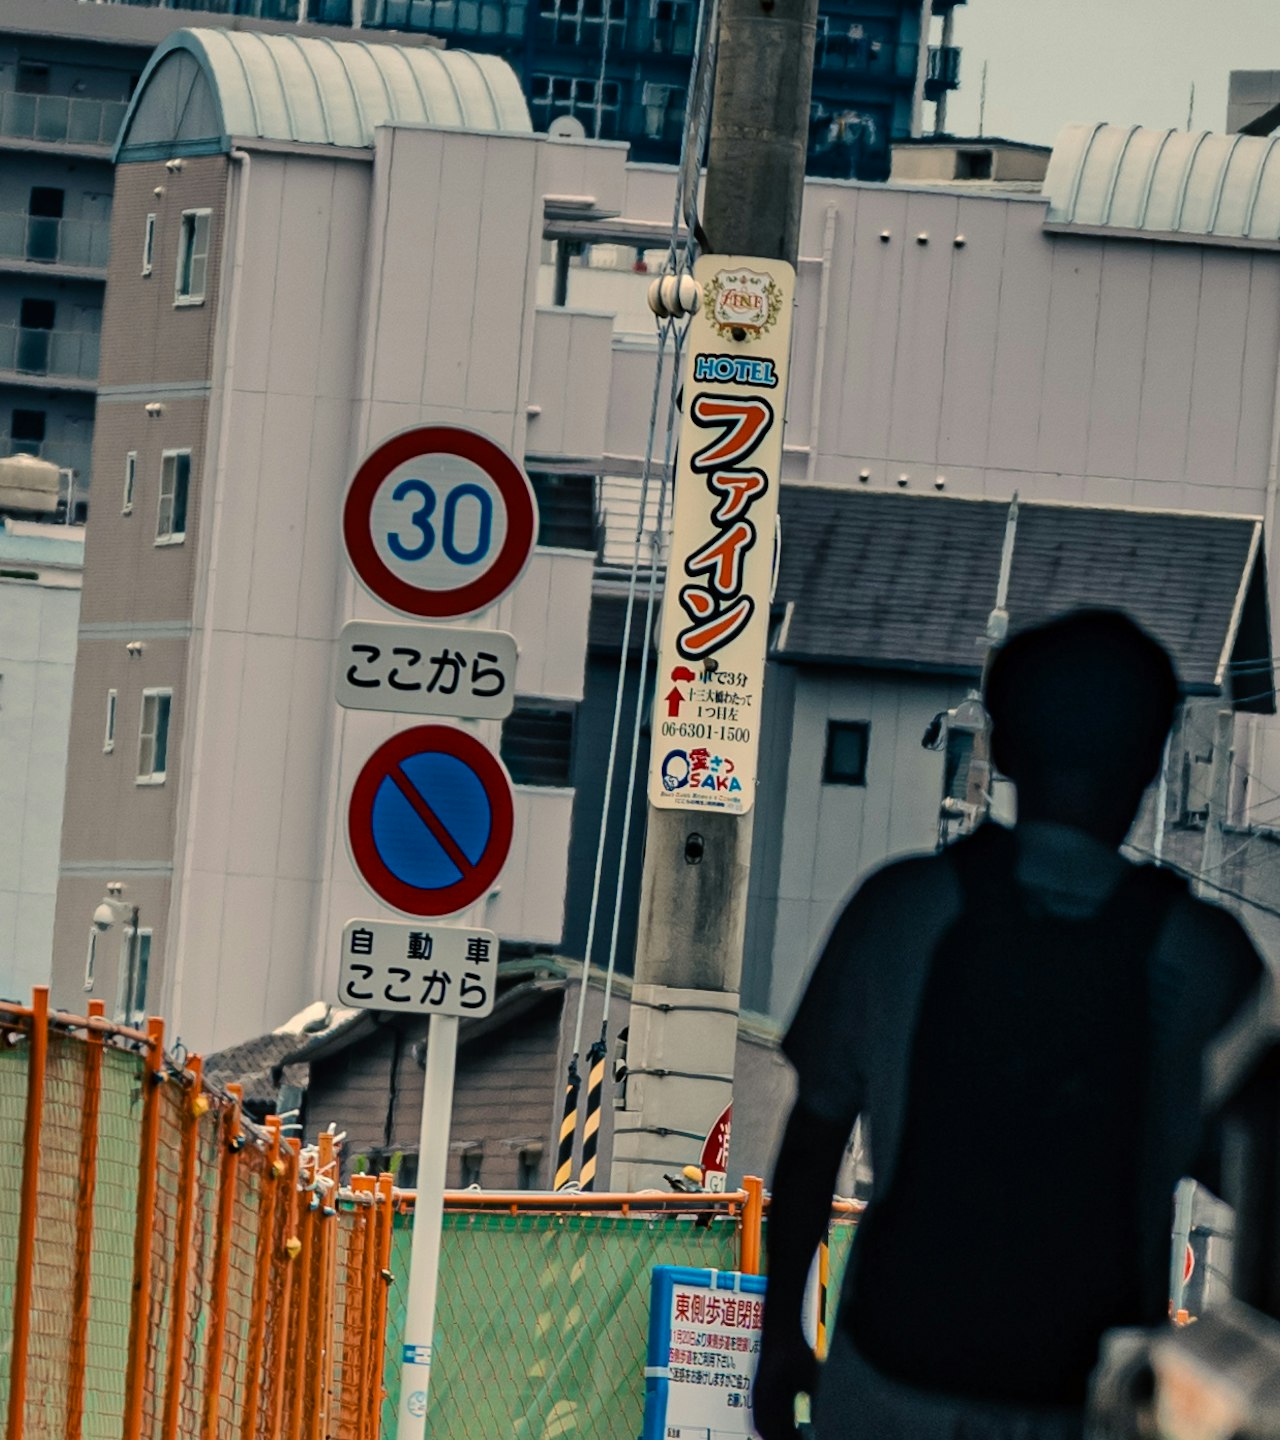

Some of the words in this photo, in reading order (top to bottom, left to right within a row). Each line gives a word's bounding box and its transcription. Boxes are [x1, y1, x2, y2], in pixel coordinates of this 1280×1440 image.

[695, 355, 777, 387] HOTEL
[387, 478, 493, 565] 30
[677, 394, 773, 659] ファイン
[346, 644, 506, 697] ここから
[661, 721, 751, 744] 06-6301-1500
[351, 927, 491, 966] 自動車
[346, 963, 487, 1010] ここから
